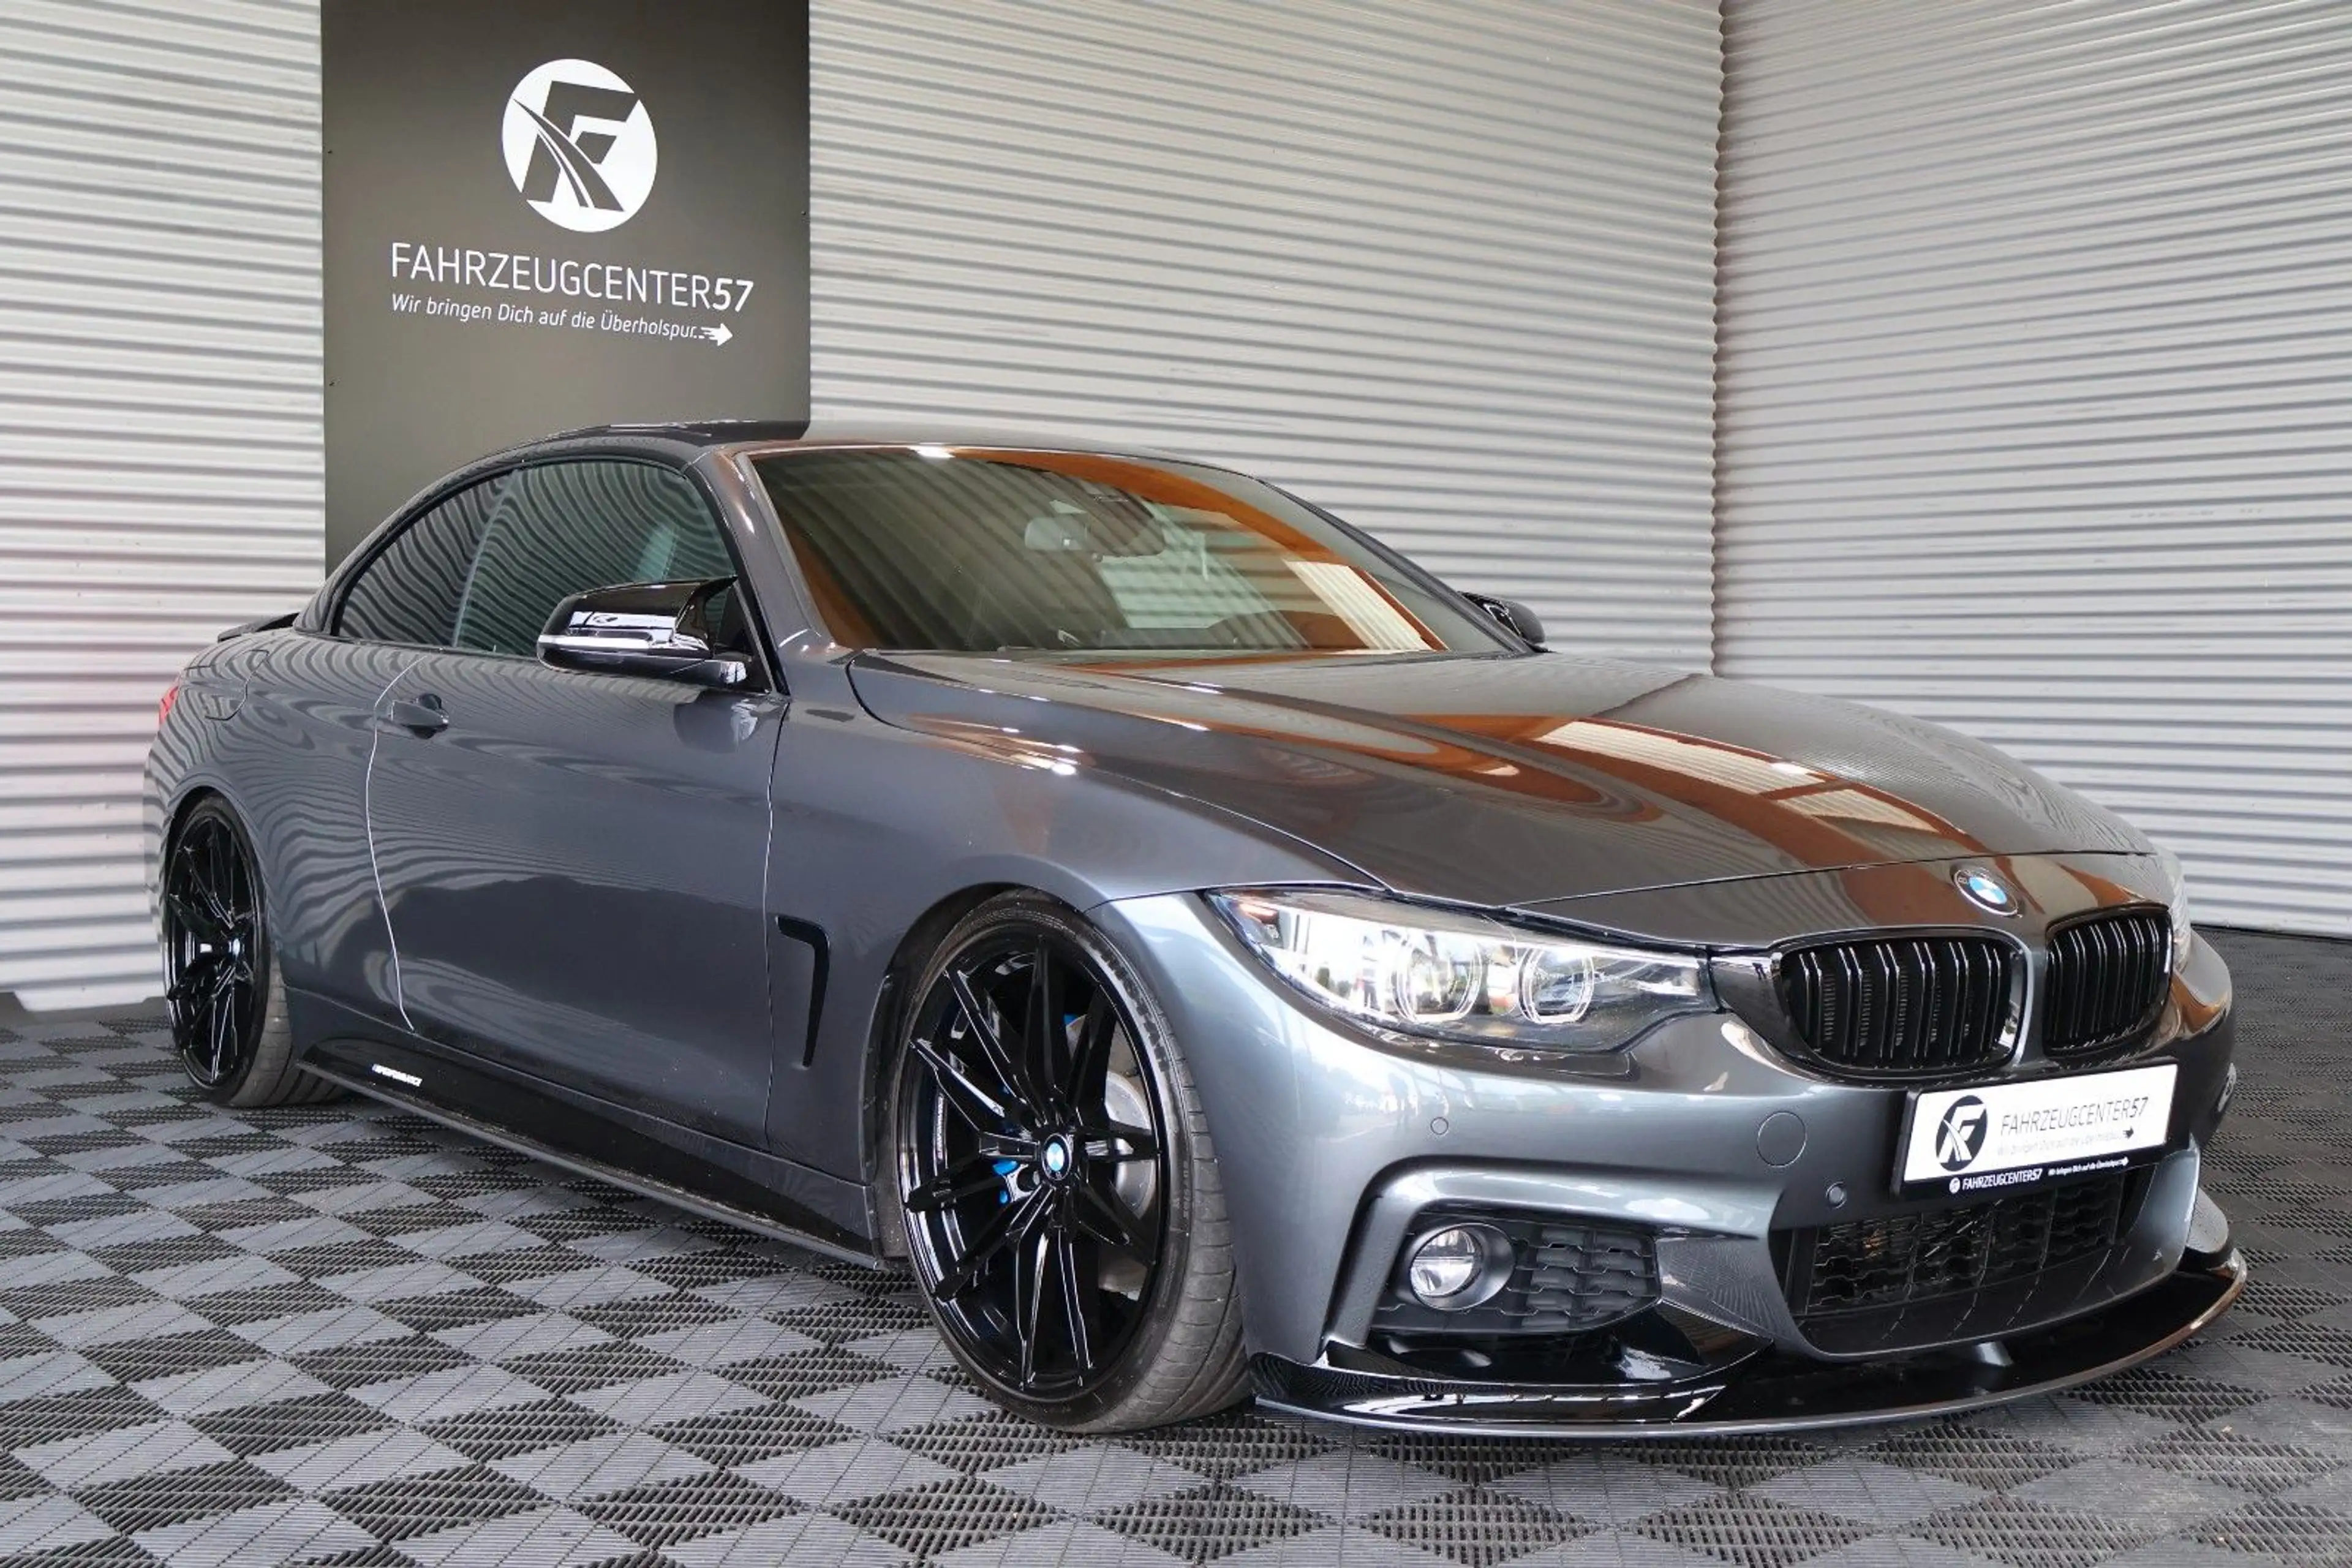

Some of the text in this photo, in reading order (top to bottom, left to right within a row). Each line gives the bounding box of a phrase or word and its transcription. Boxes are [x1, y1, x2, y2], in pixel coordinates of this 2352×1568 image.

[391, 241, 755, 313] FAHRZEUGCENTER57
[391, 293, 421, 313] Wir
[426, 296, 492, 323] bringen
[497, 303, 533, 324] Dich
[538, 309, 568, 326] auf
[571, 311, 595, 330] die
[2000, 1095, 2149, 1136] FAHRZEUGCENTER57
[1961, 1167, 2043, 1191] FAHRZEUGCENTER57
